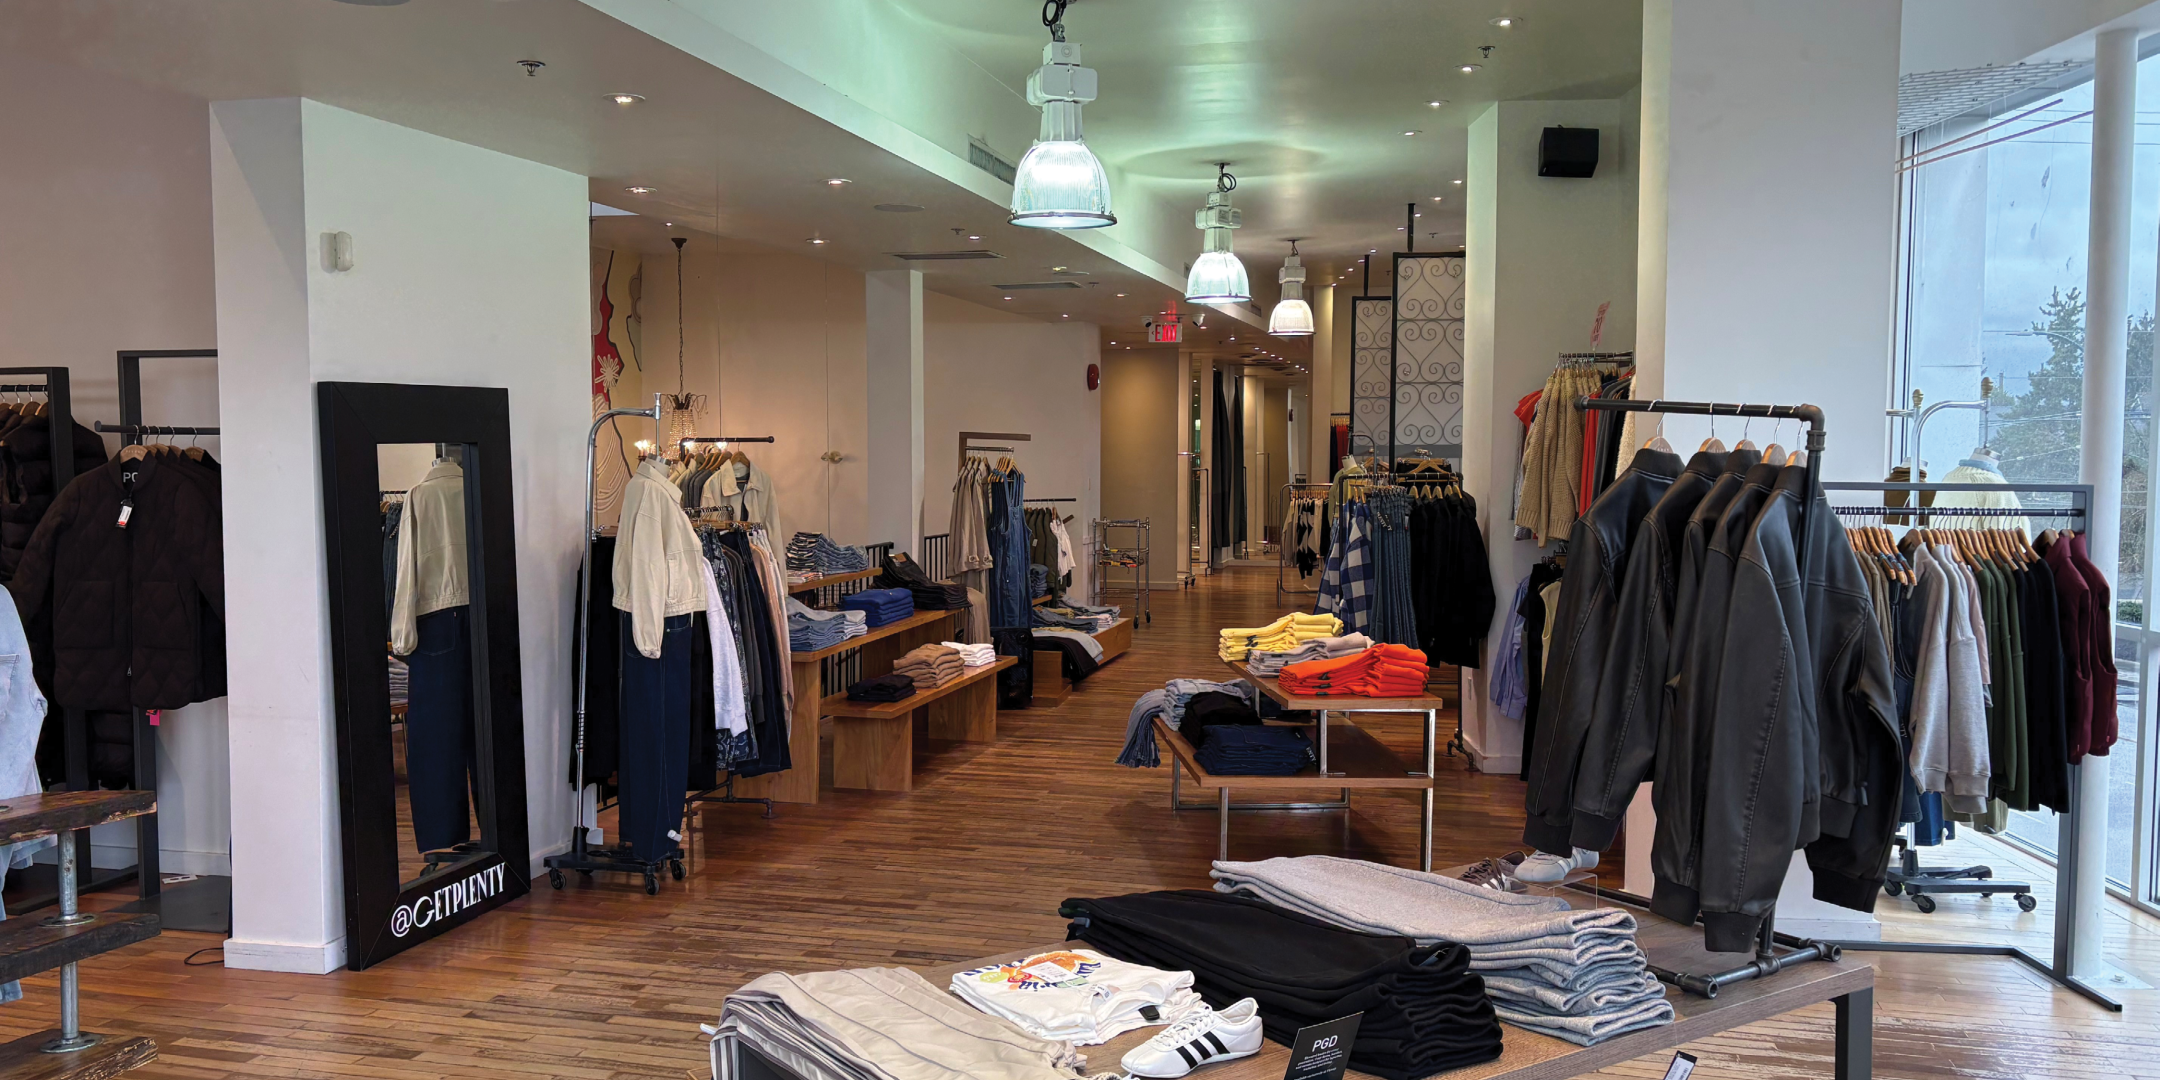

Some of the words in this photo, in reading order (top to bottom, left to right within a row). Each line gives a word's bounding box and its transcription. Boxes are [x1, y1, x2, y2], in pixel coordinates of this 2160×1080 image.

[1155, 324, 1178, 342] EXIT
[390, 861, 506, 938] @GETPLENTY
[1311, 1034, 1339, 1053] PGD
